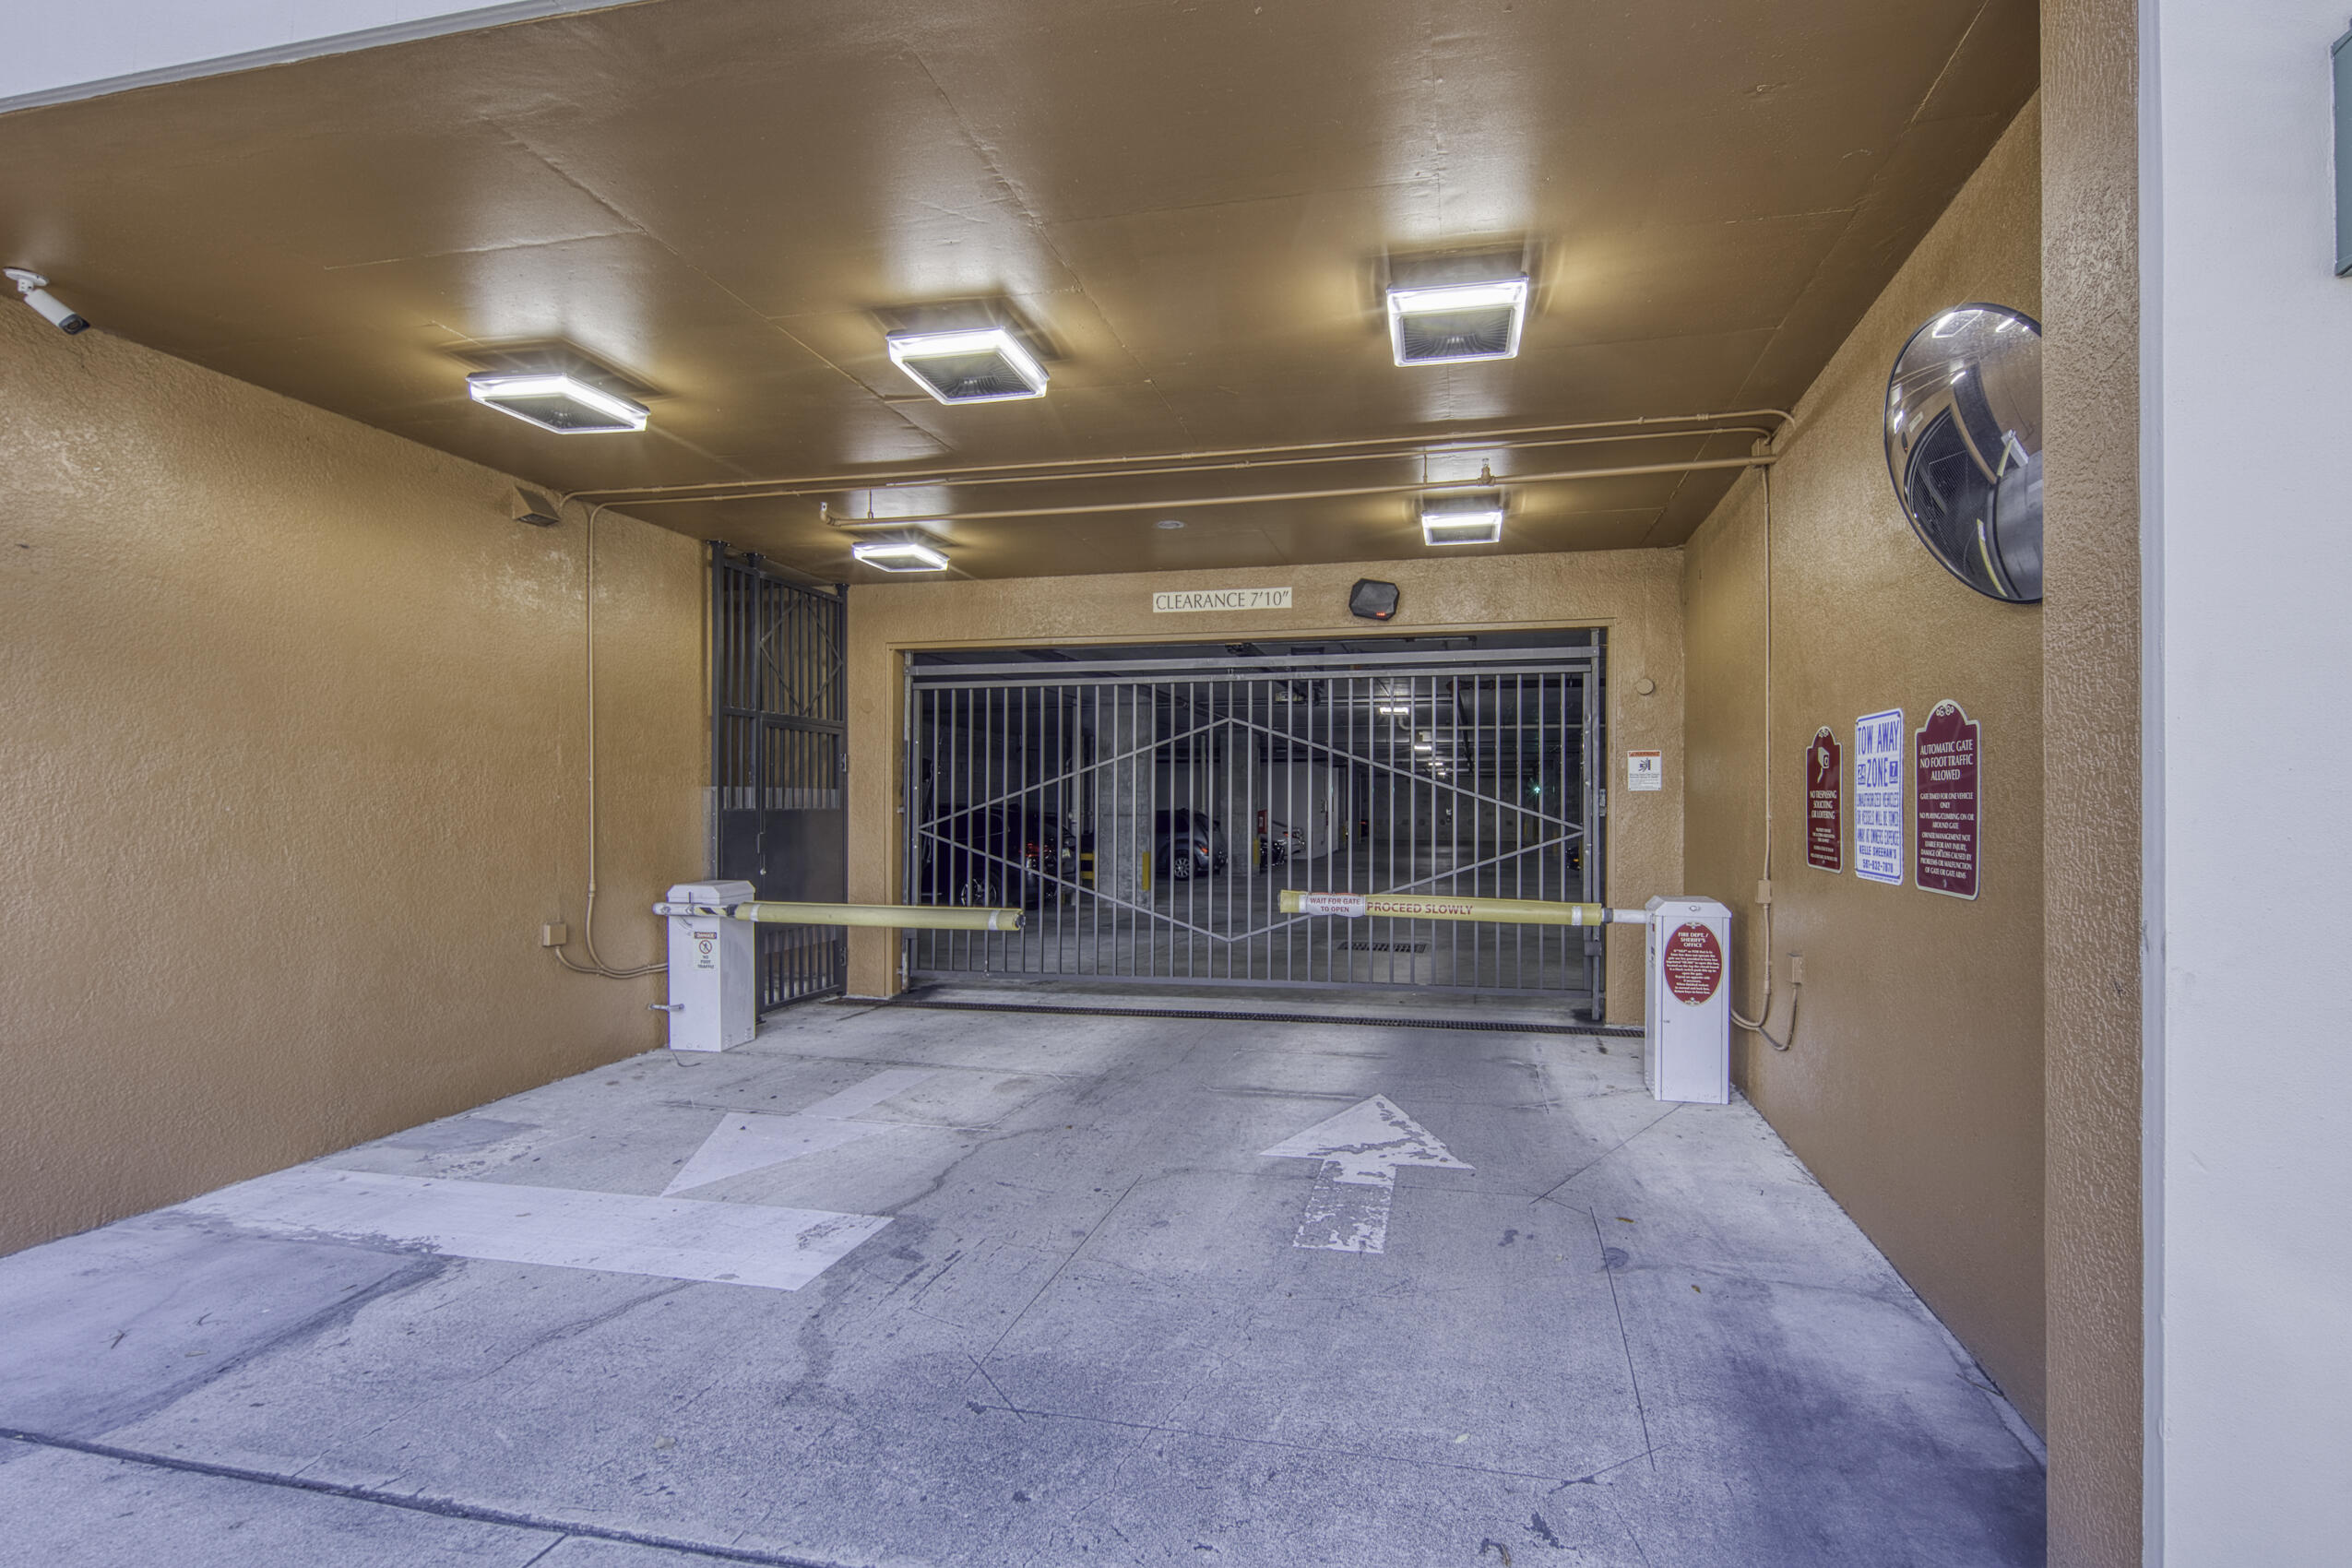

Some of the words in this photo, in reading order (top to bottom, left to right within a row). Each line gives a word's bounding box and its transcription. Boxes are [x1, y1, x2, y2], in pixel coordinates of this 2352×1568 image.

[1157, 592, 1244, 610] CLEARANCE
[1251, 590, 1289, 607] 7'10"
[1858, 725, 1873, 755] TOW
[1877, 719, 1899, 753] AWAY
[1920, 742, 1955, 754] AUTOMATIC
[1956, 739, 1973, 752] GATE
[1920, 758, 1930, 768] NO
[1930, 756, 1947, 767] FOOT
[1948, 754, 1973, 766] TRAFFIC
[1867, 757, 1888, 788] ZONE
[1930, 769, 1960, 780] ALLOWED
[1367, 902, 1422, 913] PROCEED
[1425, 904, 1473, 915] SLOWLY
